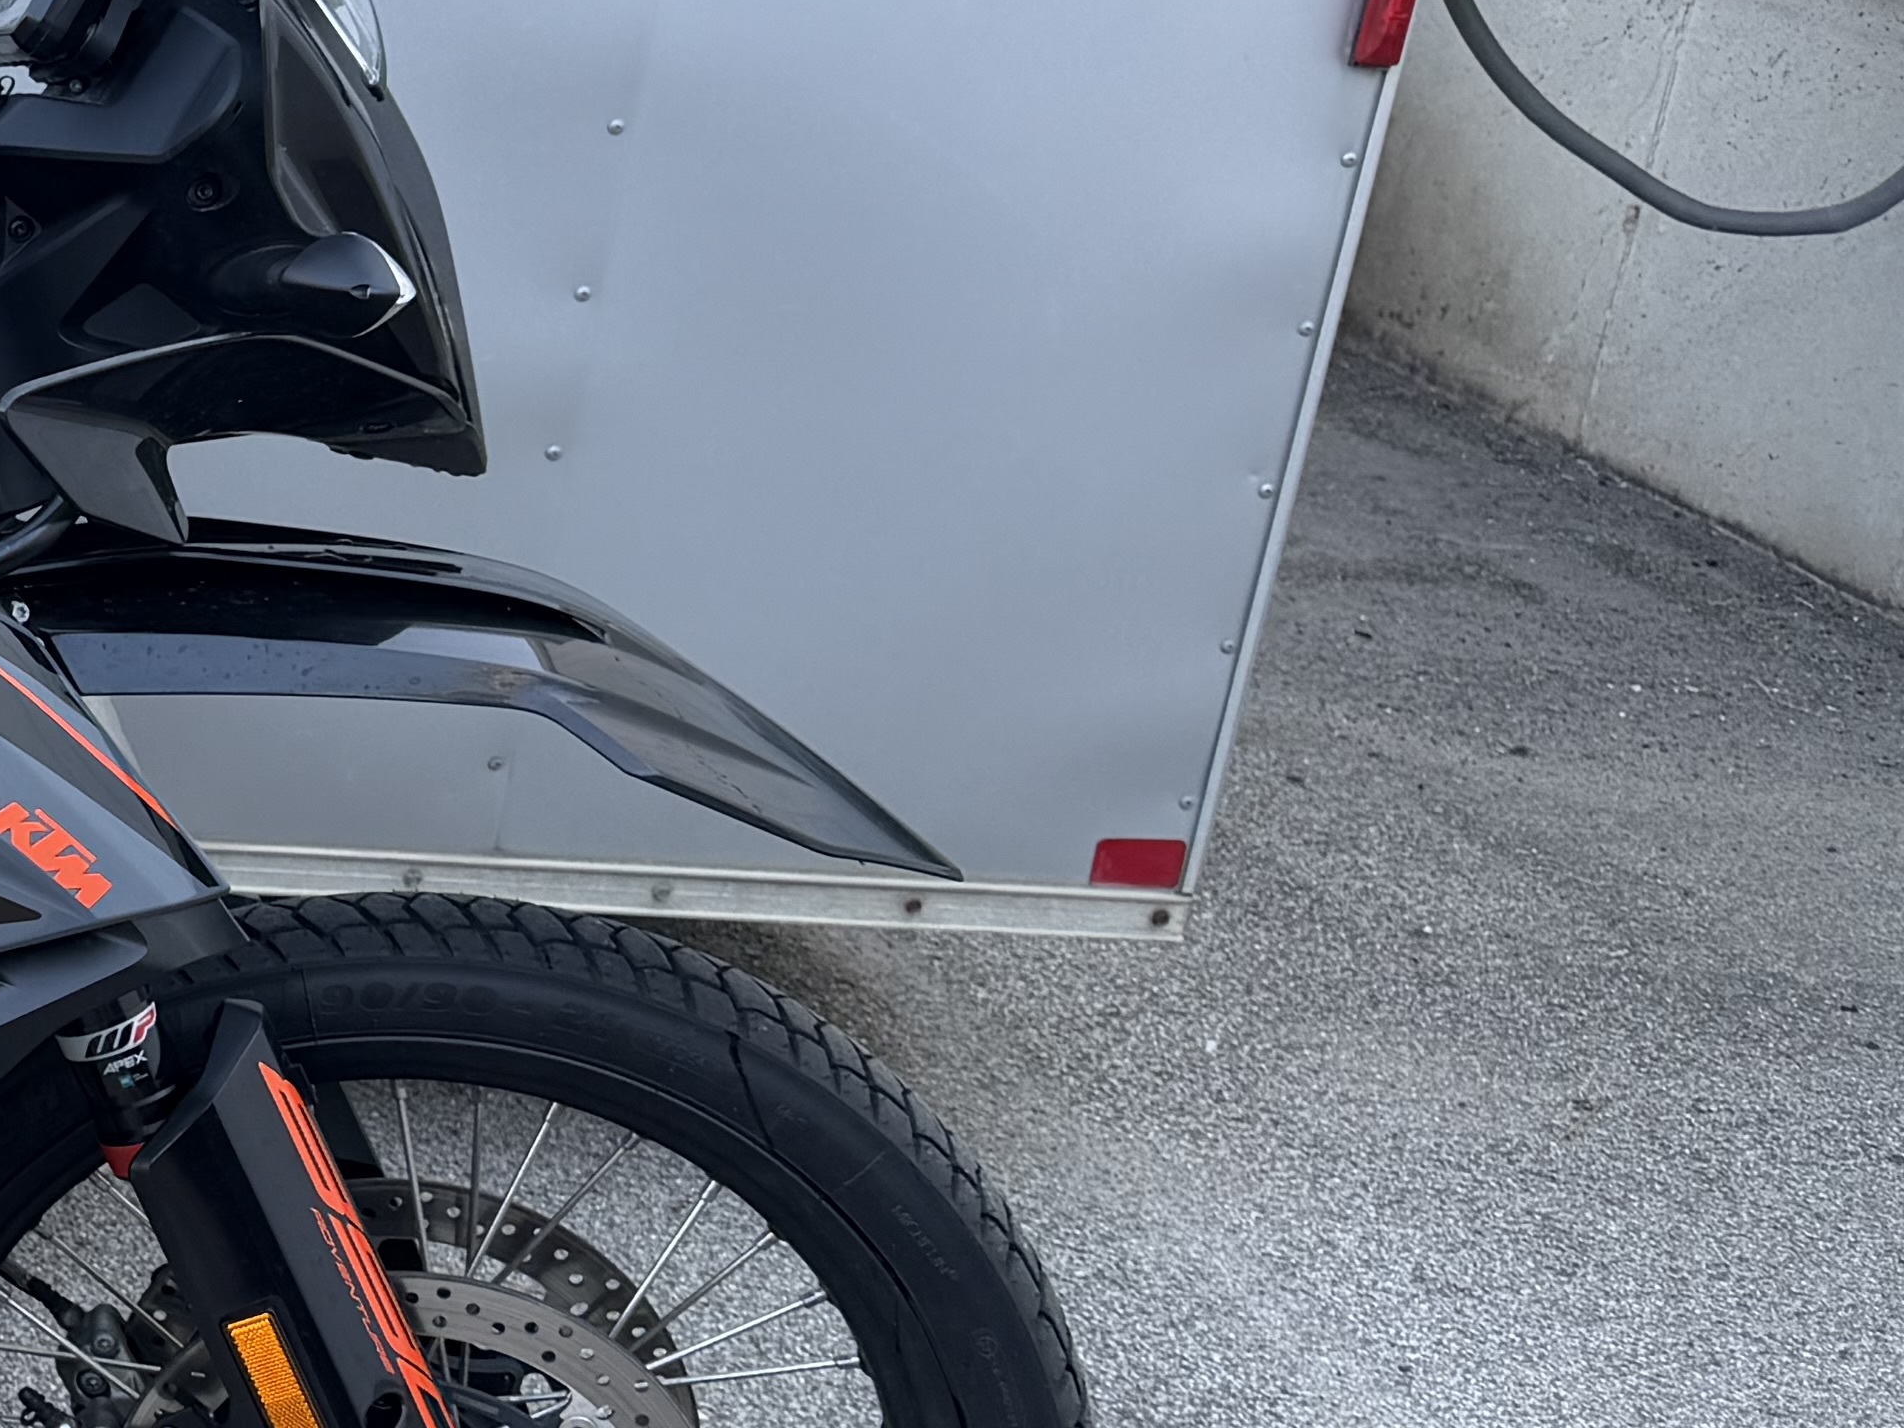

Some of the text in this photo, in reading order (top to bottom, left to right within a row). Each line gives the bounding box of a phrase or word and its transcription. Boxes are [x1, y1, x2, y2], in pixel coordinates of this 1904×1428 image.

[85, 1009, 155, 1058] WP
[103, 1049, 148, 1076] APEX
[309, 1205, 395, 1375] ADVENTURE
